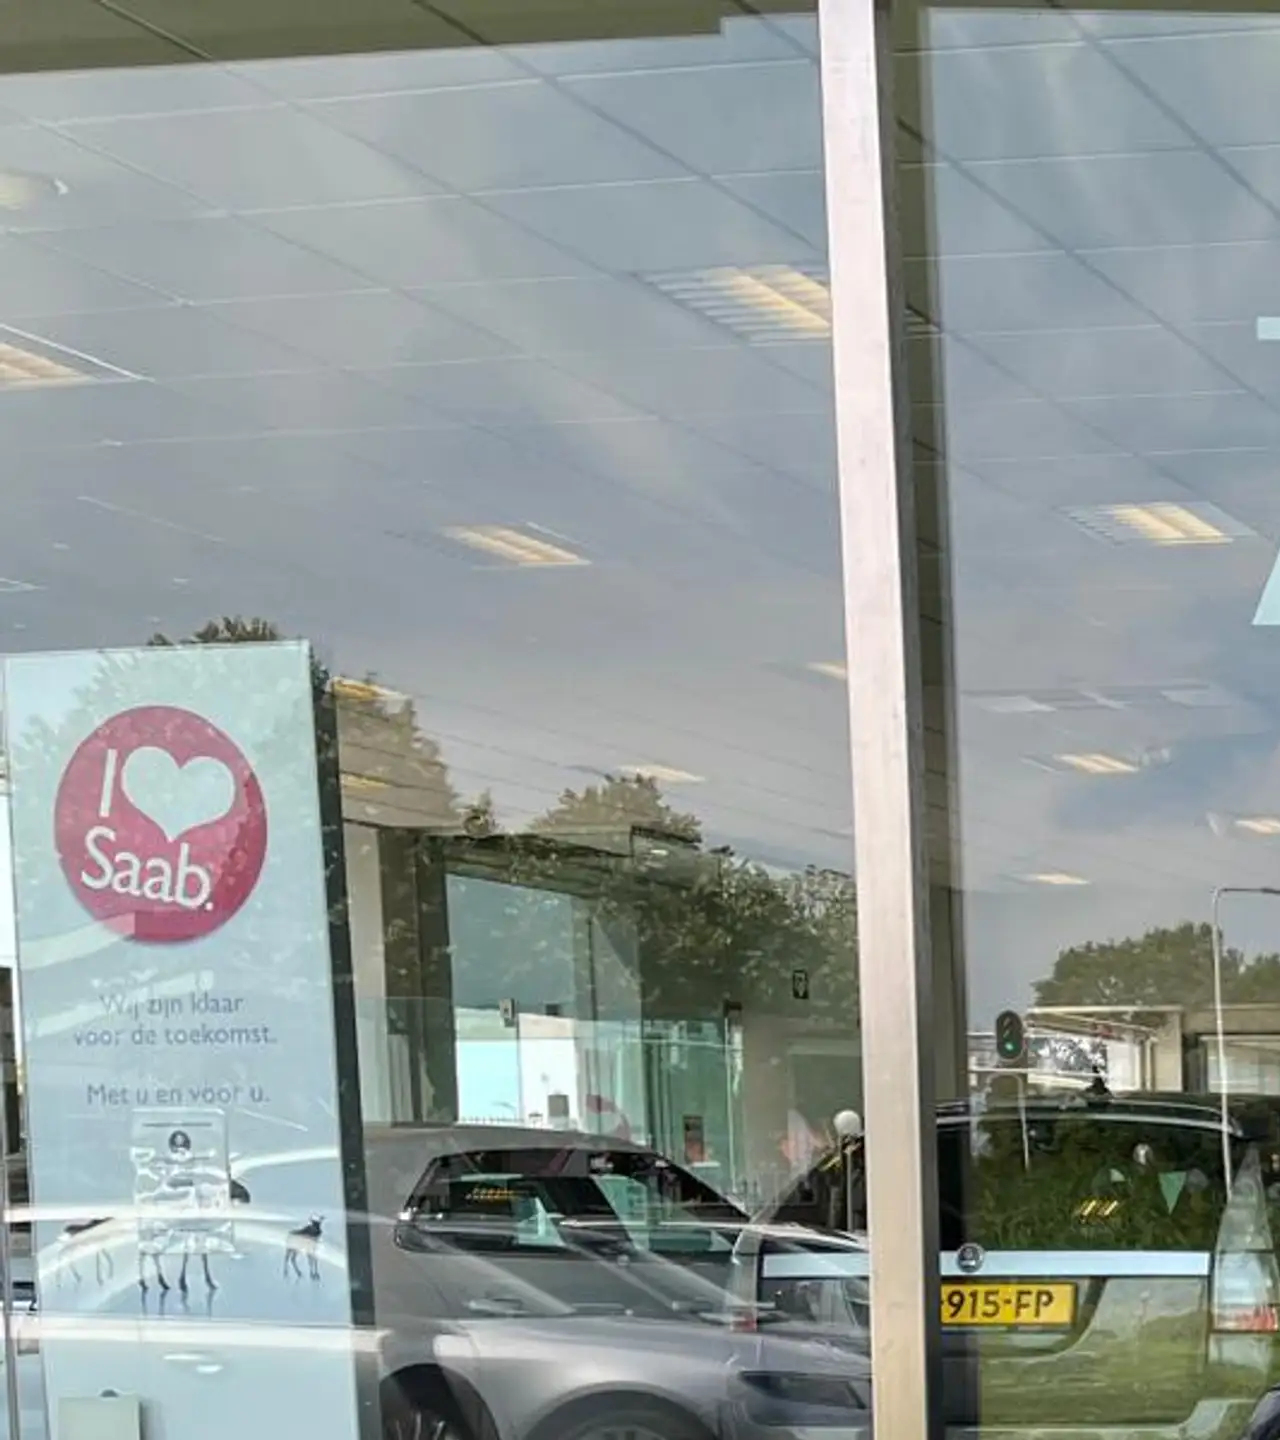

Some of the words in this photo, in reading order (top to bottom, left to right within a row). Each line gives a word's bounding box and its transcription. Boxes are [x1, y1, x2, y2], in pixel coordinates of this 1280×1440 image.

[191, 991, 244, 1015] klaar
[74, 1029, 127, 1046] voor
[131, 1023, 157, 1045] de
[86, 1084, 129, 1105] Met
[136, 1087, 149, 1105] u
[156, 1087, 183, 1105] en
[188, 1086, 244, 1105] voor
